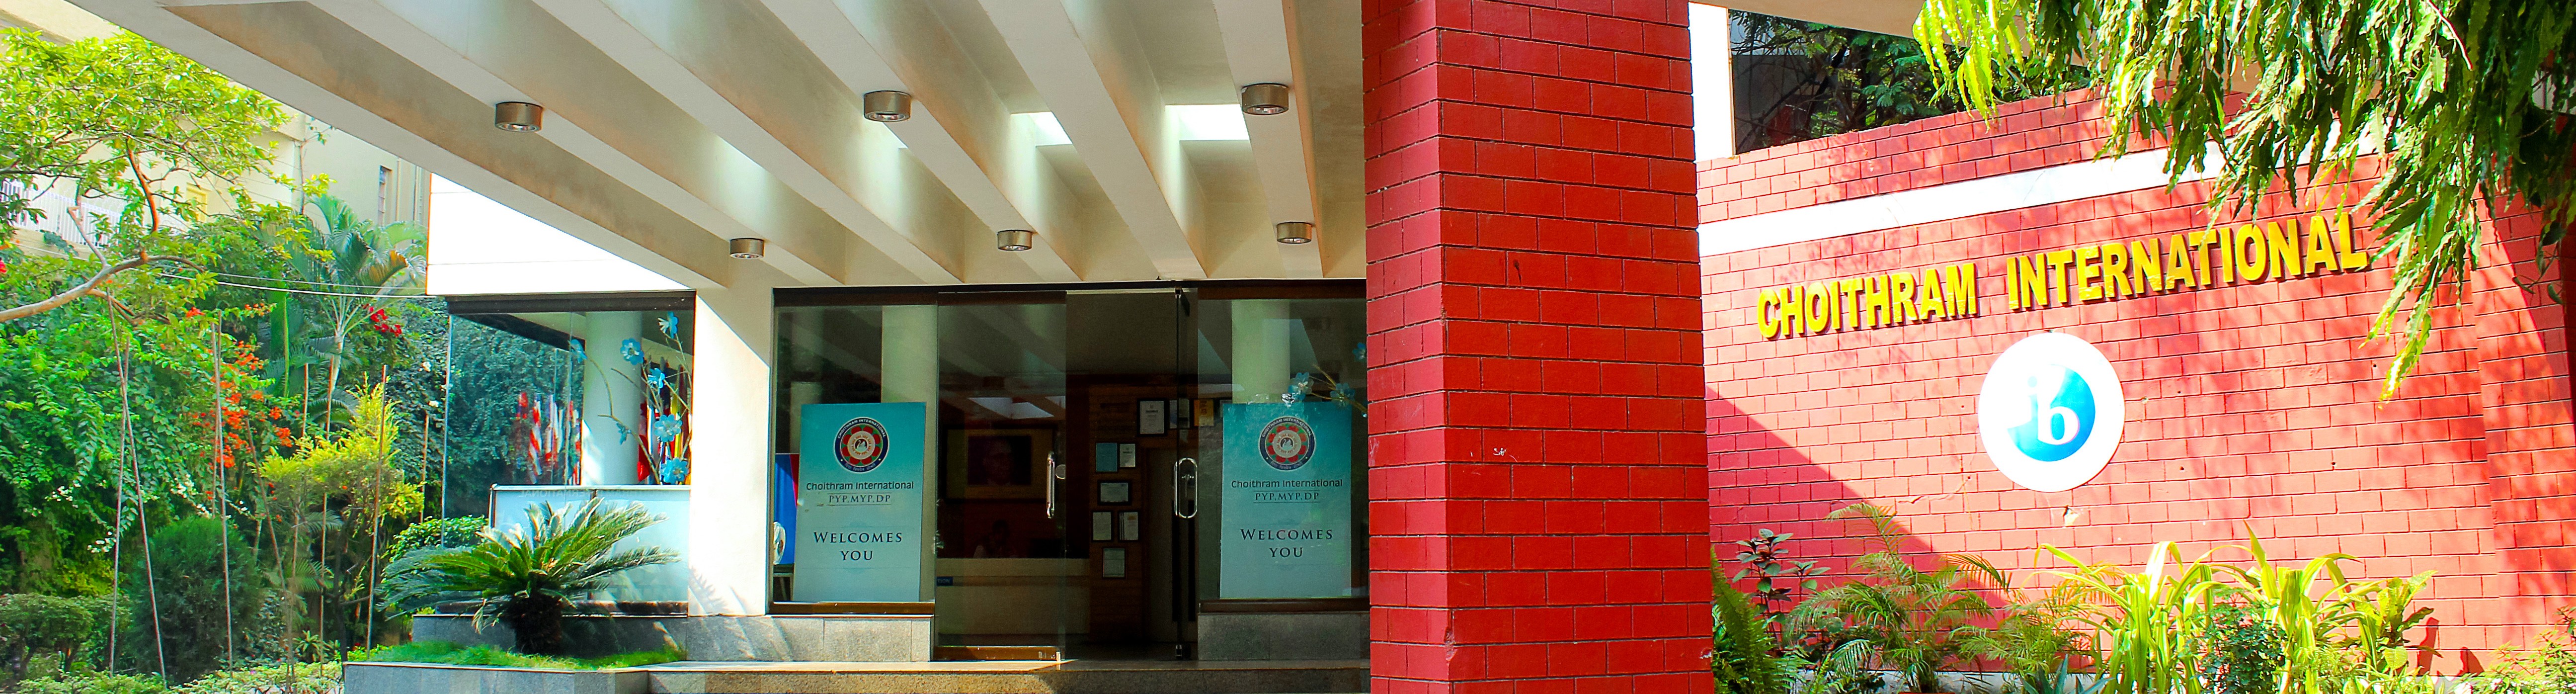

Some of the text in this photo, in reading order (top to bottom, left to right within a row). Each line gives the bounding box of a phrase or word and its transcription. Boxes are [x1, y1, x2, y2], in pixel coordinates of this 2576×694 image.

[1757, 212, 2367, 340] CHOITHRAM INTERNATIONAL
[837, 419, 886, 438] CHOITHRAM INTERNATIONAL
[1262, 418, 1312, 437] CHOITHRAM INTERNATIONAL
[856, 481, 914, 490] International
[813, 531, 902, 543] WELCOMES
[1240, 528, 1333, 540] WELCOMES
[841, 550, 873, 561] YOU
[1269, 547, 1303, 558] YOU
